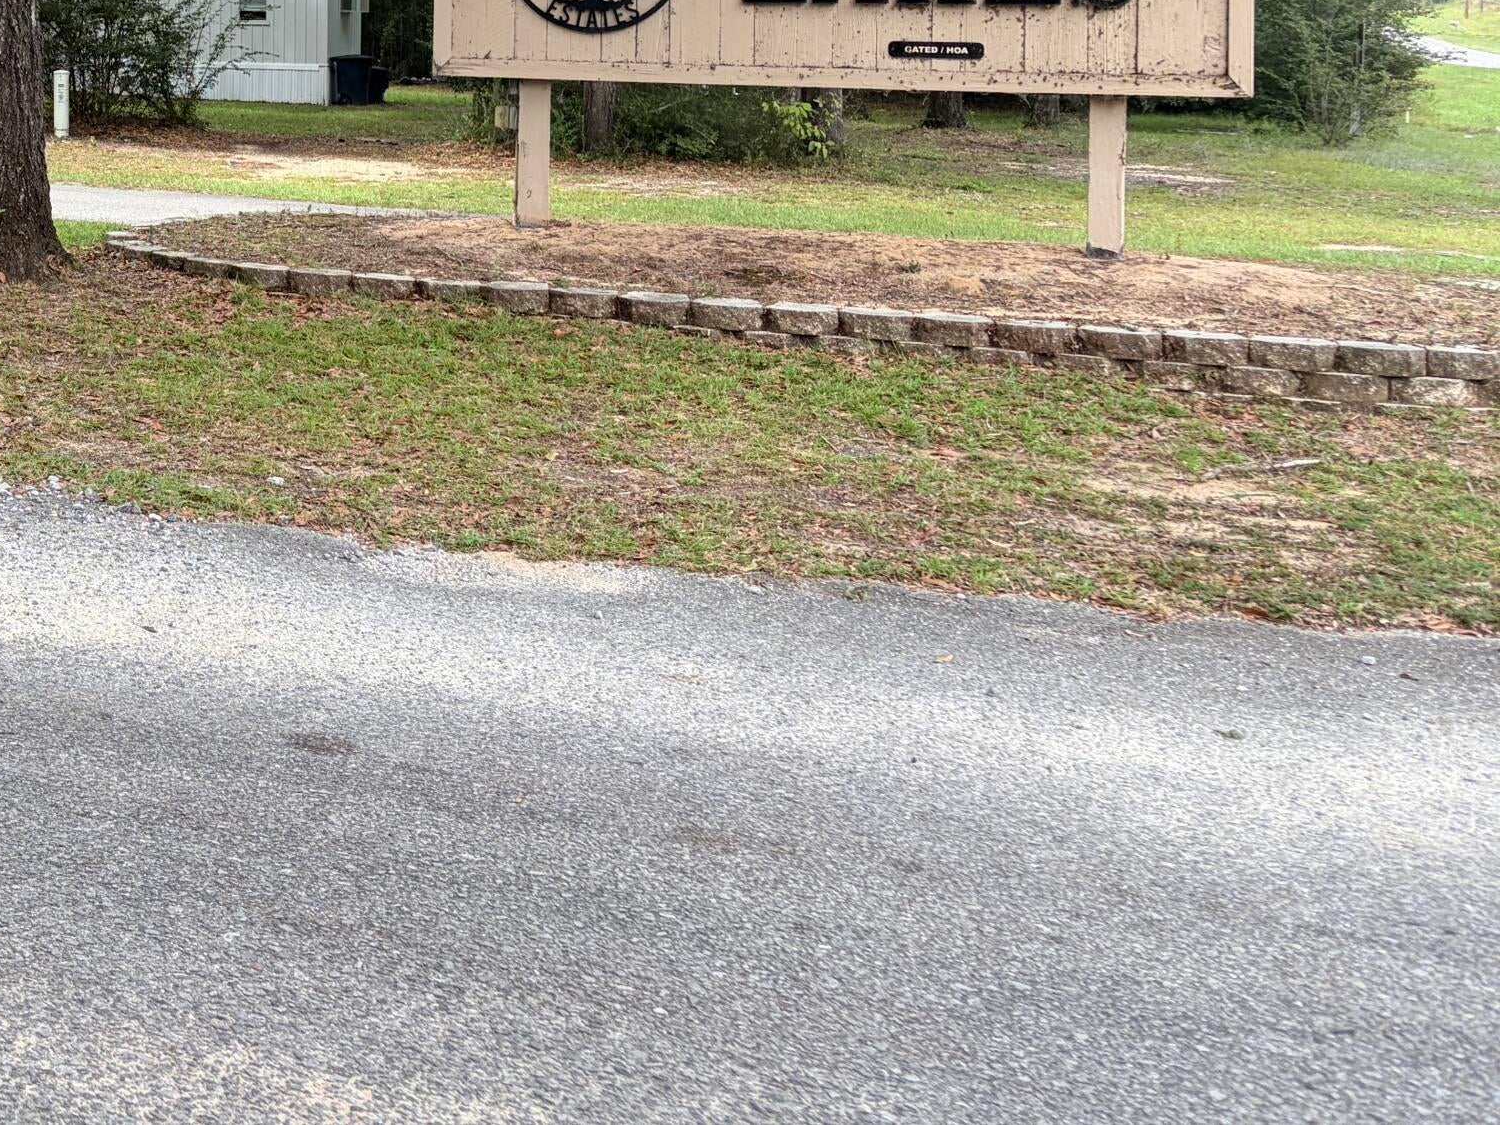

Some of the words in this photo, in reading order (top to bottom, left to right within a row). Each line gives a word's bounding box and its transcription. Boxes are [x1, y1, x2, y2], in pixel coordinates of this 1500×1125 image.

[546, 0, 641, 27] ESTATES
[904, 45, 939, 54] GATED
[946, 46, 969, 54] HOA
